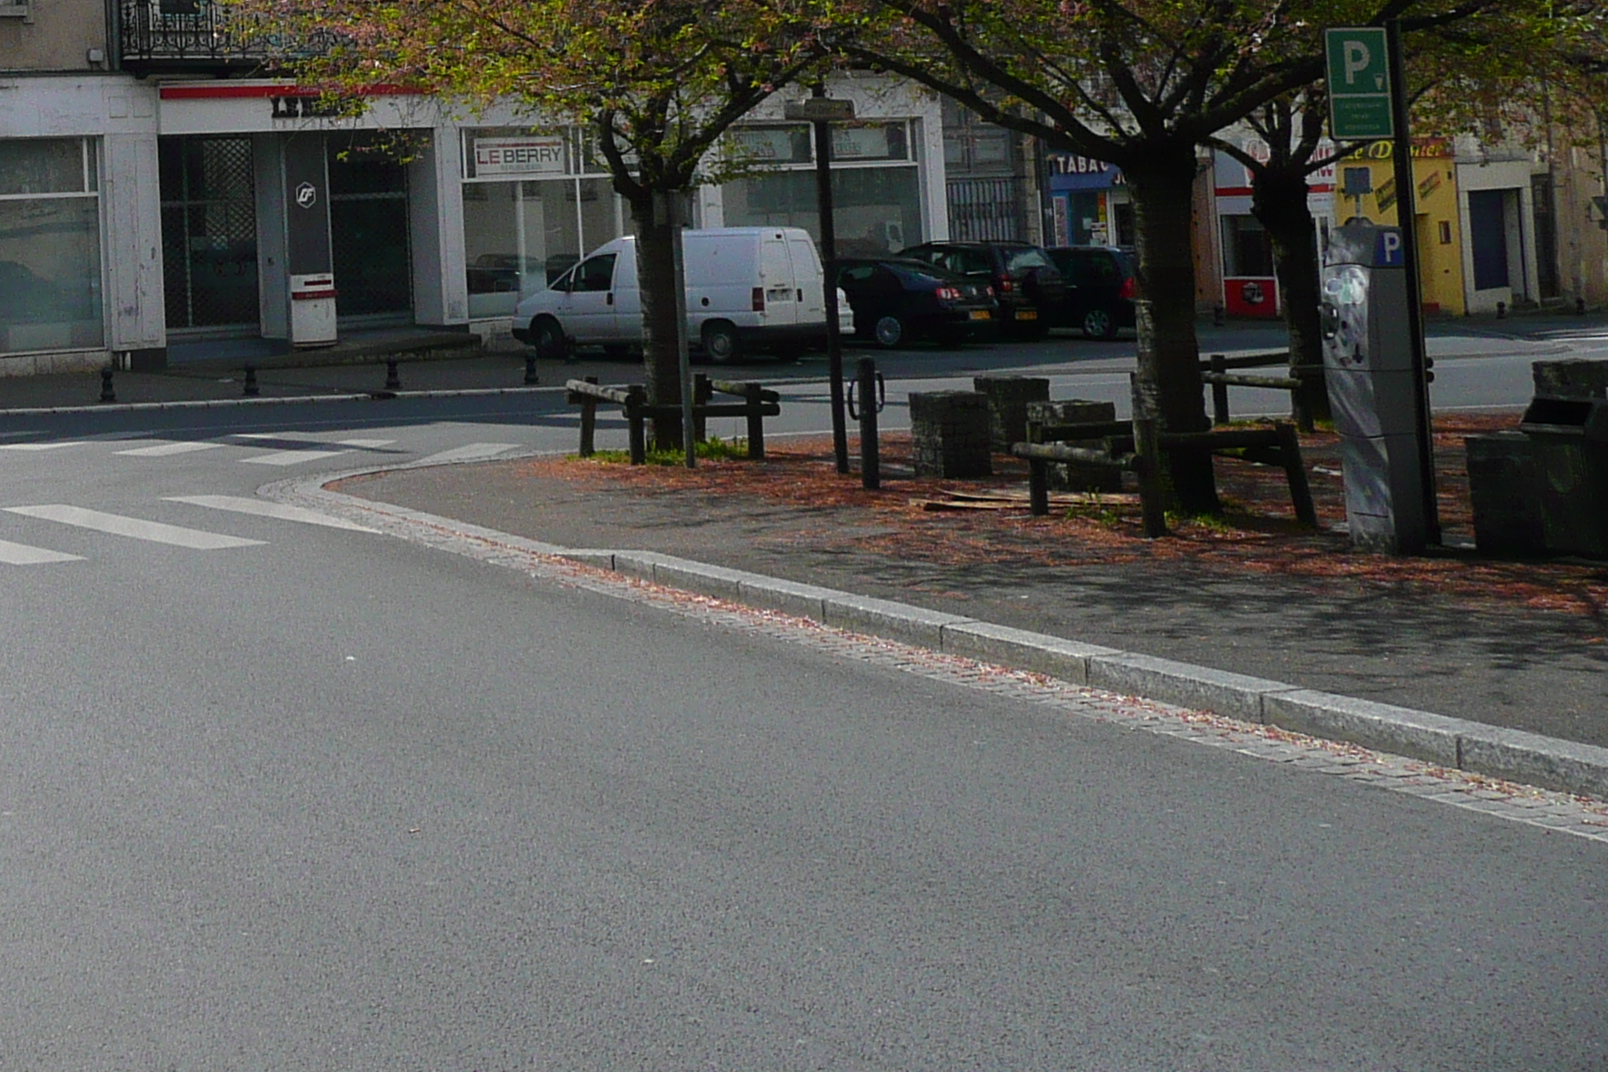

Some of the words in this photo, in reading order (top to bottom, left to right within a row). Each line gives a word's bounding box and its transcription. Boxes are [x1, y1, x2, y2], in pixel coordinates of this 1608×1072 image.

[1343, 40, 1370, 85] P
[477, 150, 501, 165] LE
[503, 148, 561, 164] BERRY
[1383, 232, 1400, 263] P
